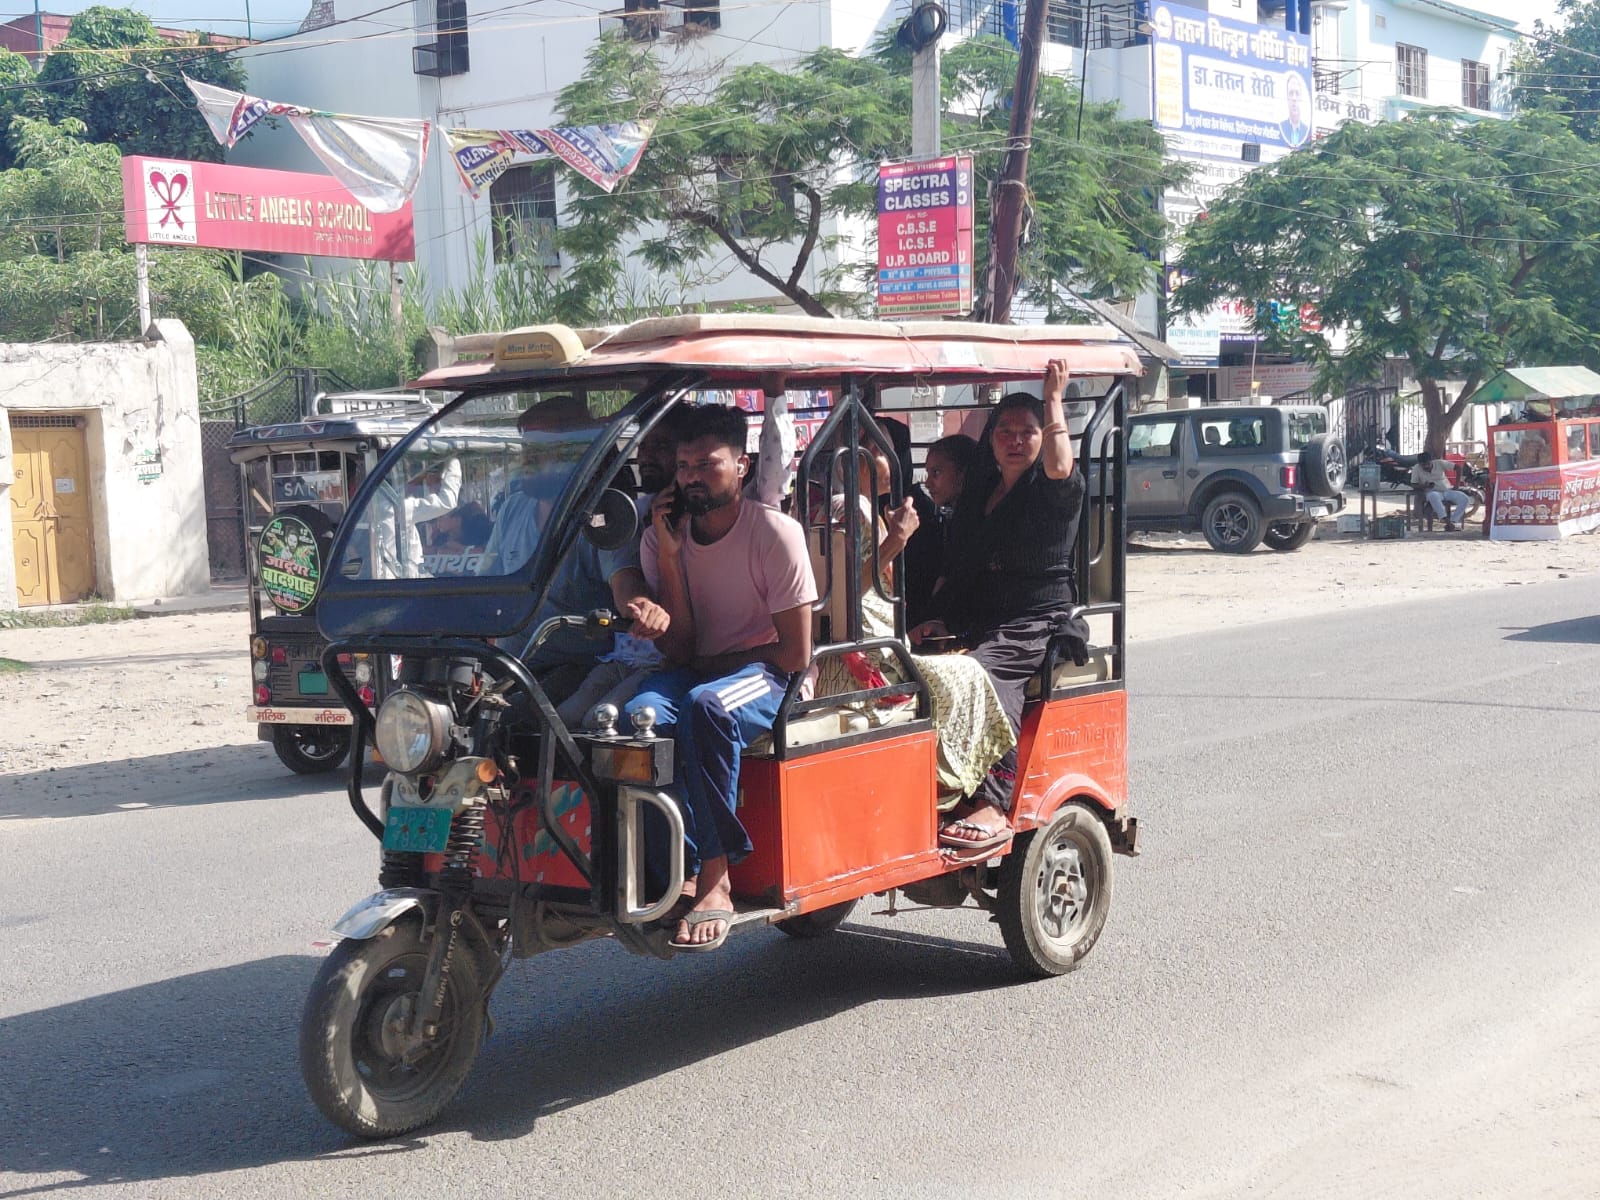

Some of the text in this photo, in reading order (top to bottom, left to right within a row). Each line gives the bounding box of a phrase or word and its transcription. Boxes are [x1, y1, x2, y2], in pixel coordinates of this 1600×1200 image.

[1286, 36, 1309, 69] होम
[1251, 73, 1276, 99] सेठी
[884, 173, 950, 193] SPECTRA
[884, 191, 950, 211] CLASSES
[205, 191, 373, 232] LITTLE ANGELS SCHOOL
[896, 220, 937, 236] C.B.S.E
[898, 237, 935, 250] I.C.S.E
[885, 251, 950, 267] U.P. BOARD
[1203, 328, 1219, 338] LIMITED
[255, 708, 346, 723] मलिक मलिक
